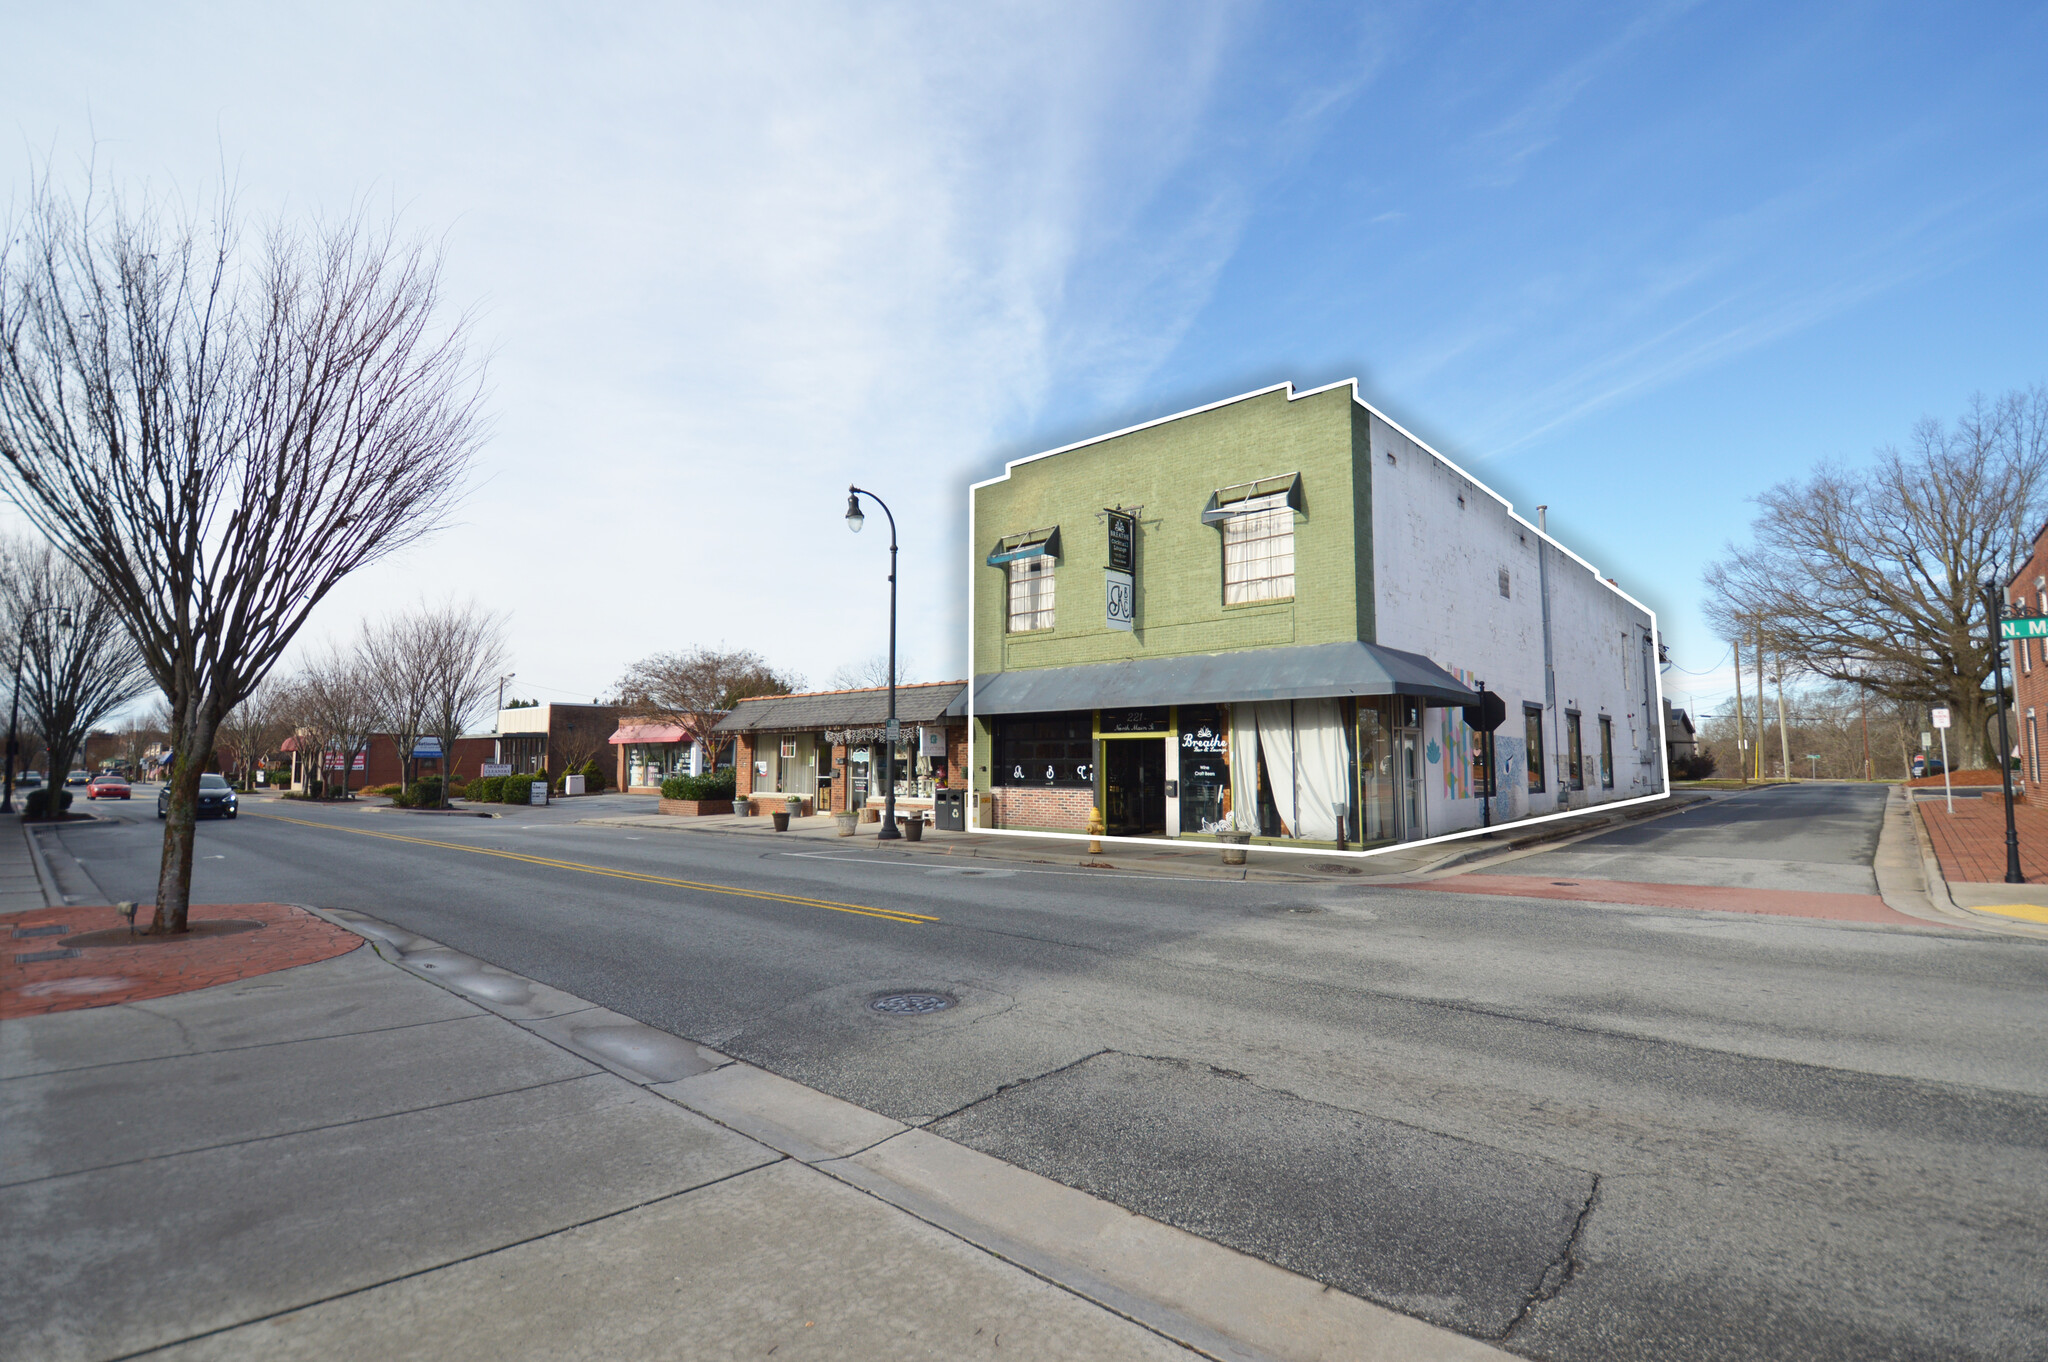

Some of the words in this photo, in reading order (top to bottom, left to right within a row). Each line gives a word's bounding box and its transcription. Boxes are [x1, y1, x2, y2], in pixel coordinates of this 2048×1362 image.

[2001, 622, 2021, 637] N.
[1127, 712, 1144, 722] 221
[1182, 733, 1228, 748] Breathe
